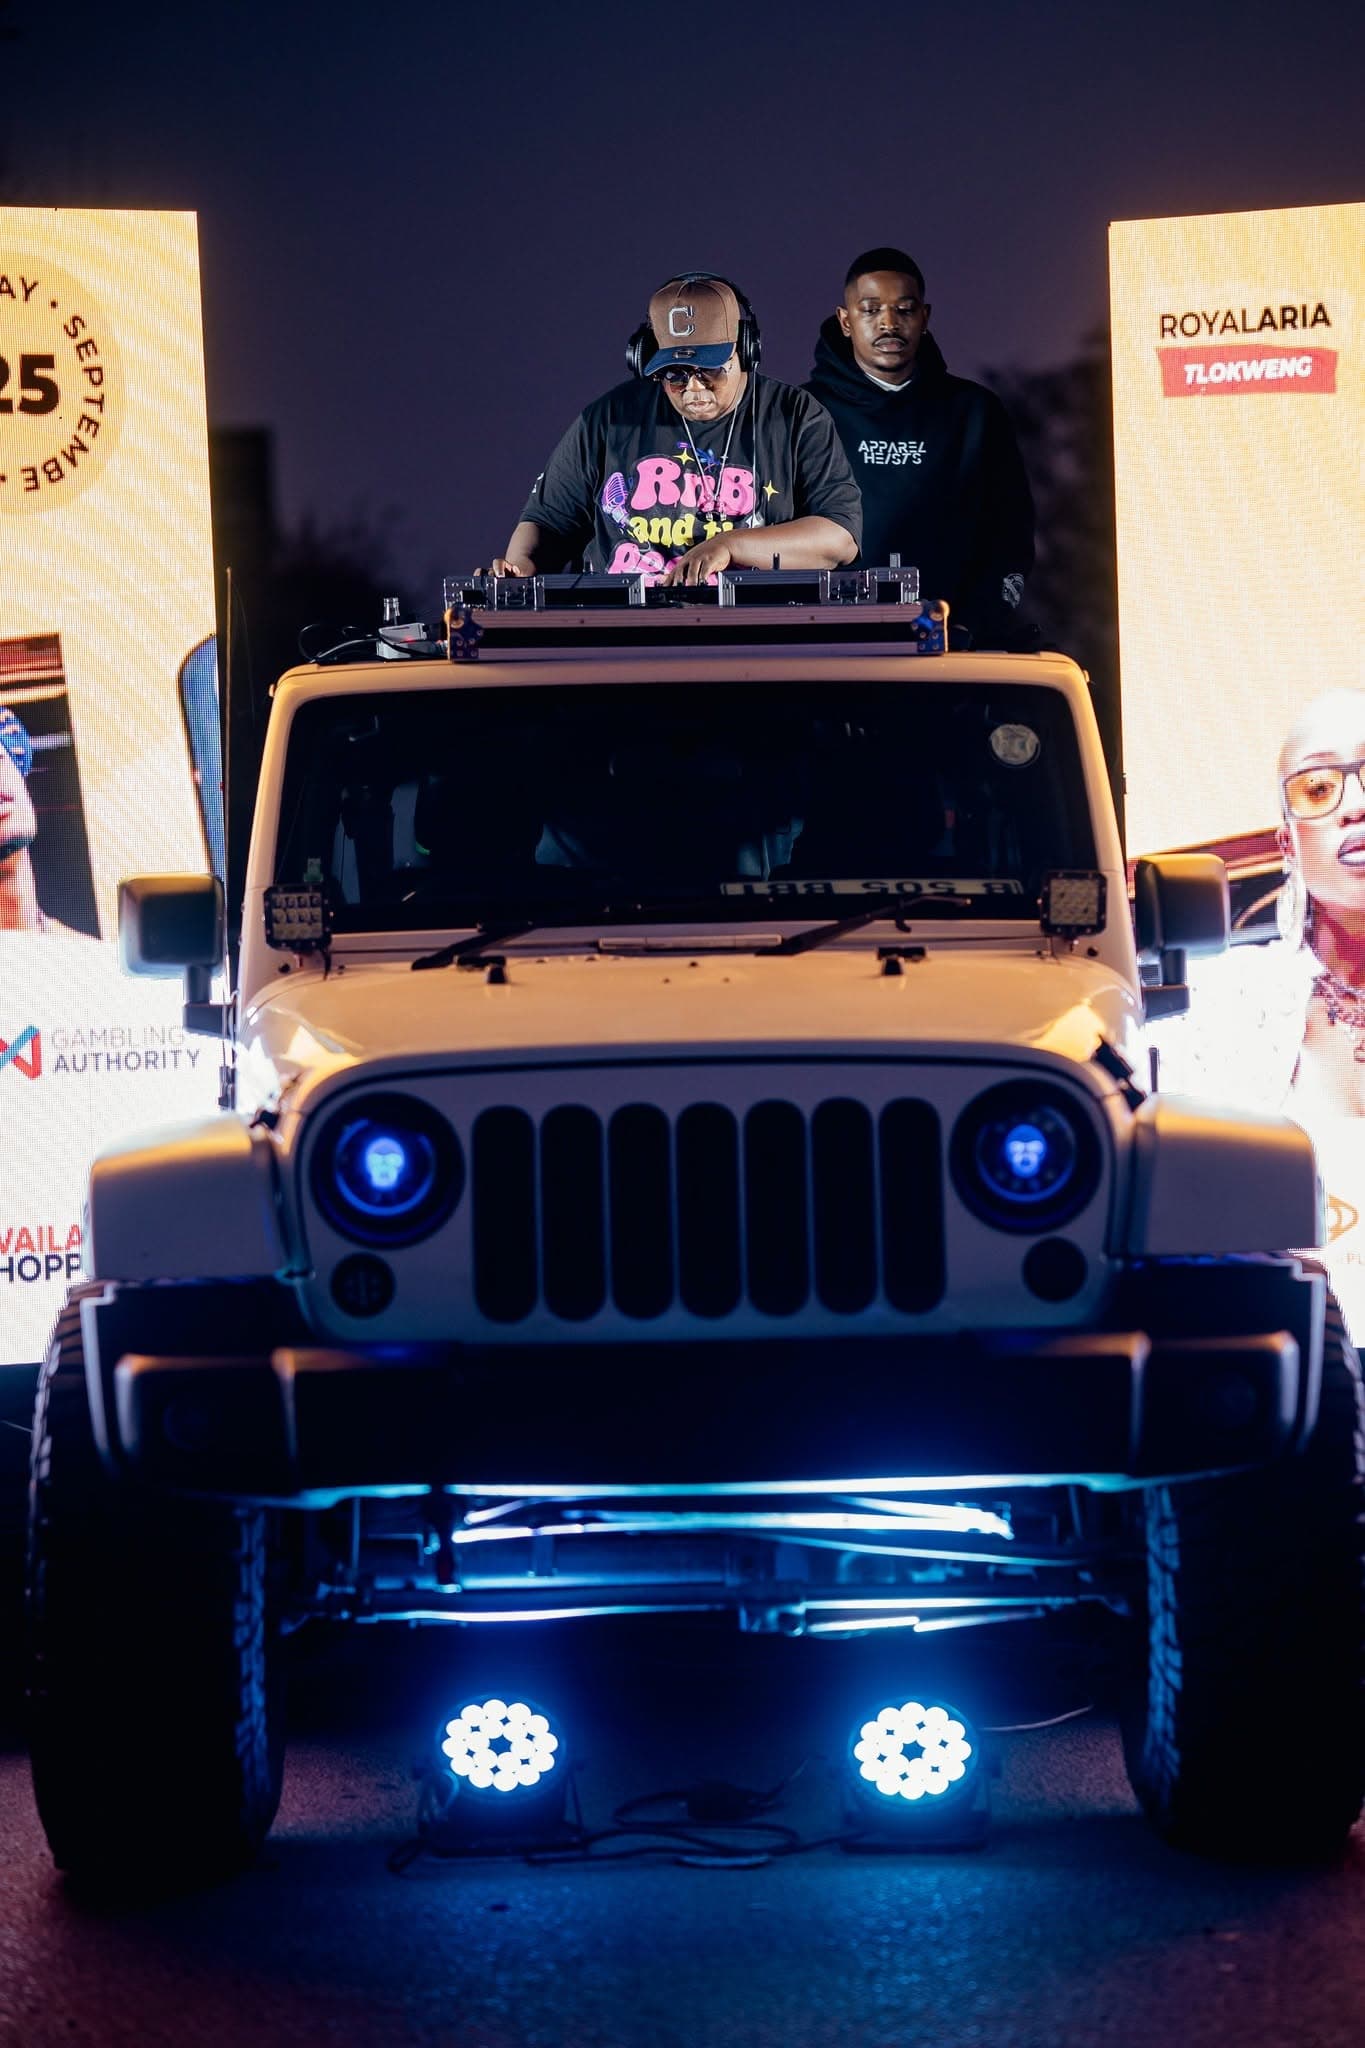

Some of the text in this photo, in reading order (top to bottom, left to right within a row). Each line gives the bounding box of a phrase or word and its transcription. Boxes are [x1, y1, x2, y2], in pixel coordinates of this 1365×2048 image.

[668, 305, 695, 337] C
[1160, 302, 1331, 339] ROYALARIA
[1184, 356, 1312, 385] TLOKWENG
[858, 440, 926, 453] APPAREL
[864, 452, 922, 465] HEISTS
[631, 457, 757, 517] RnB
[628, 513, 696, 548] and
[51, 1025, 185, 1049] GAMBLING
[53, 1048, 200, 1073] AUTHORITY
